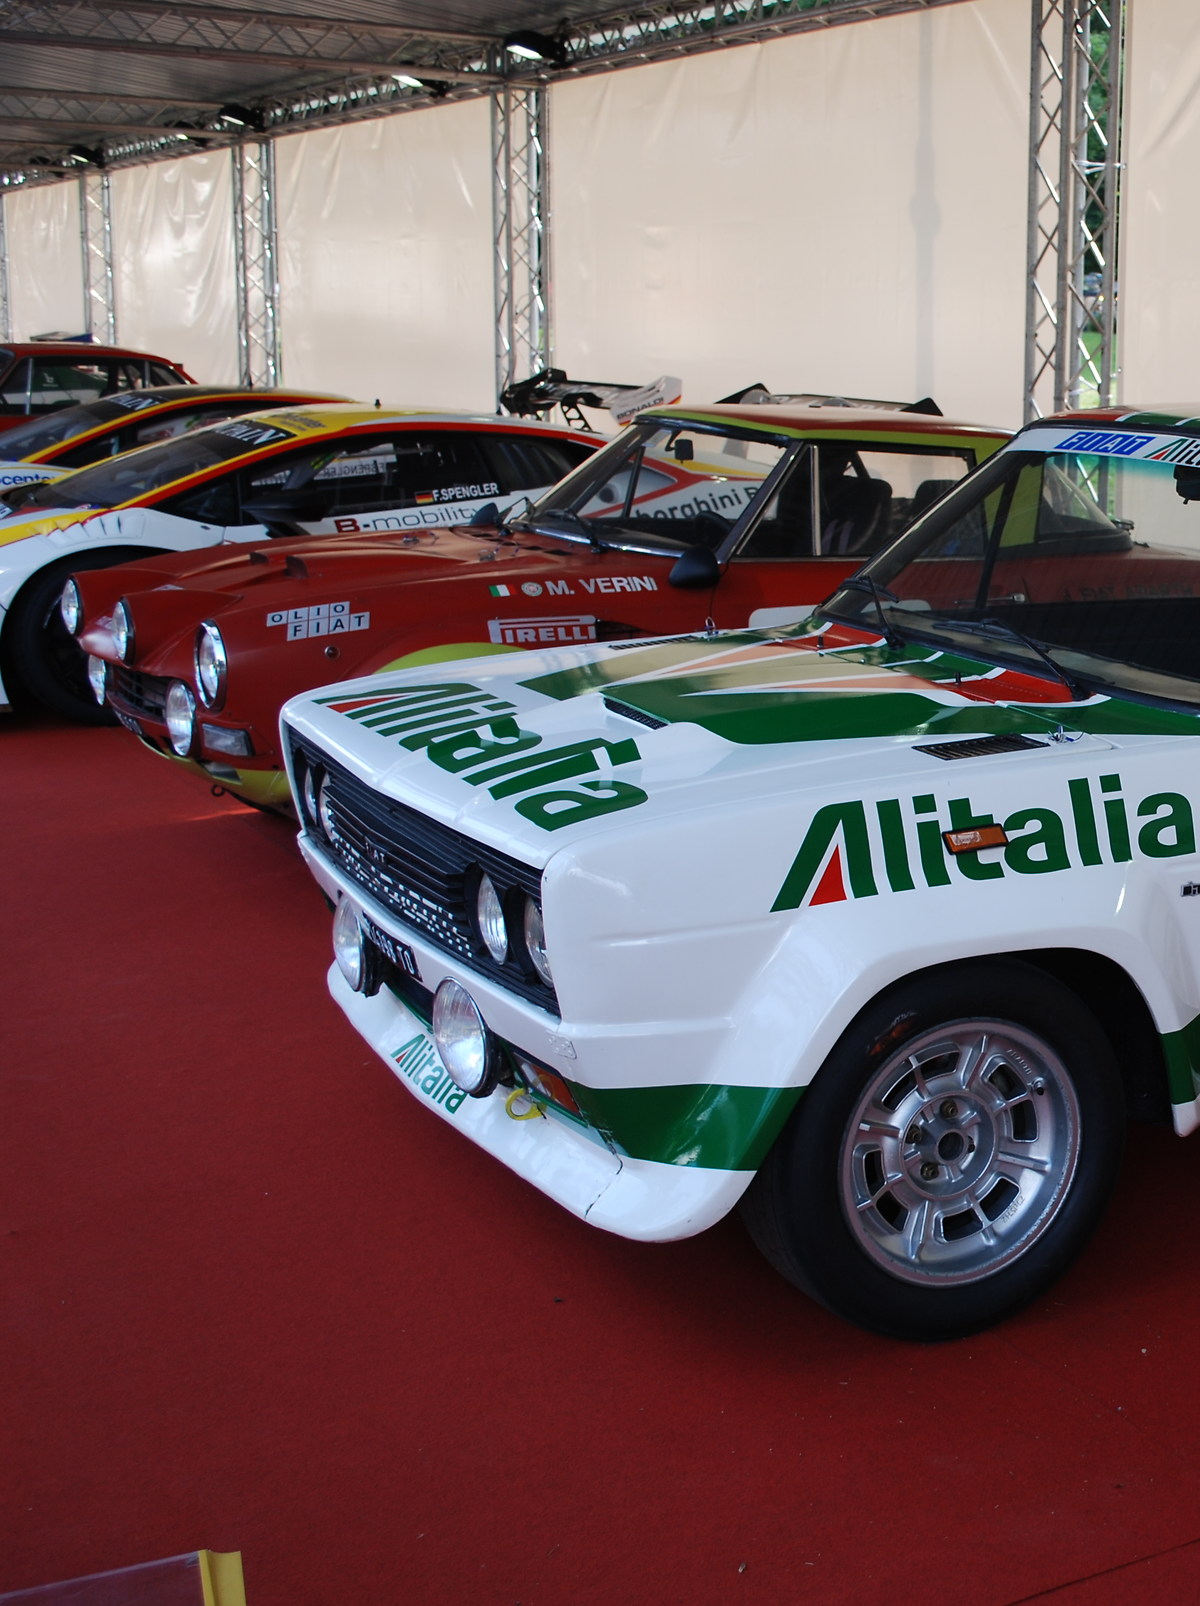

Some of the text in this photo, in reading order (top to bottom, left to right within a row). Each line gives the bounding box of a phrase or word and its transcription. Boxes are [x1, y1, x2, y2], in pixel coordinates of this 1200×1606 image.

[1057, 433, 1153, 454] FIAT
[432, 482, 499, 503] F.SPENGLER
[545, 580, 575, 597] M.
[579, 576, 659, 595] VERINI
[271, 603, 345, 624] OLIO
[293, 613, 366, 637] FIAT
[487, 614, 597, 644] PIRELLI
[311, 682, 649, 833] Alitalia
[768, 773, 1196, 913] Alitalia
[390, 1033, 468, 1115] Alitalia
